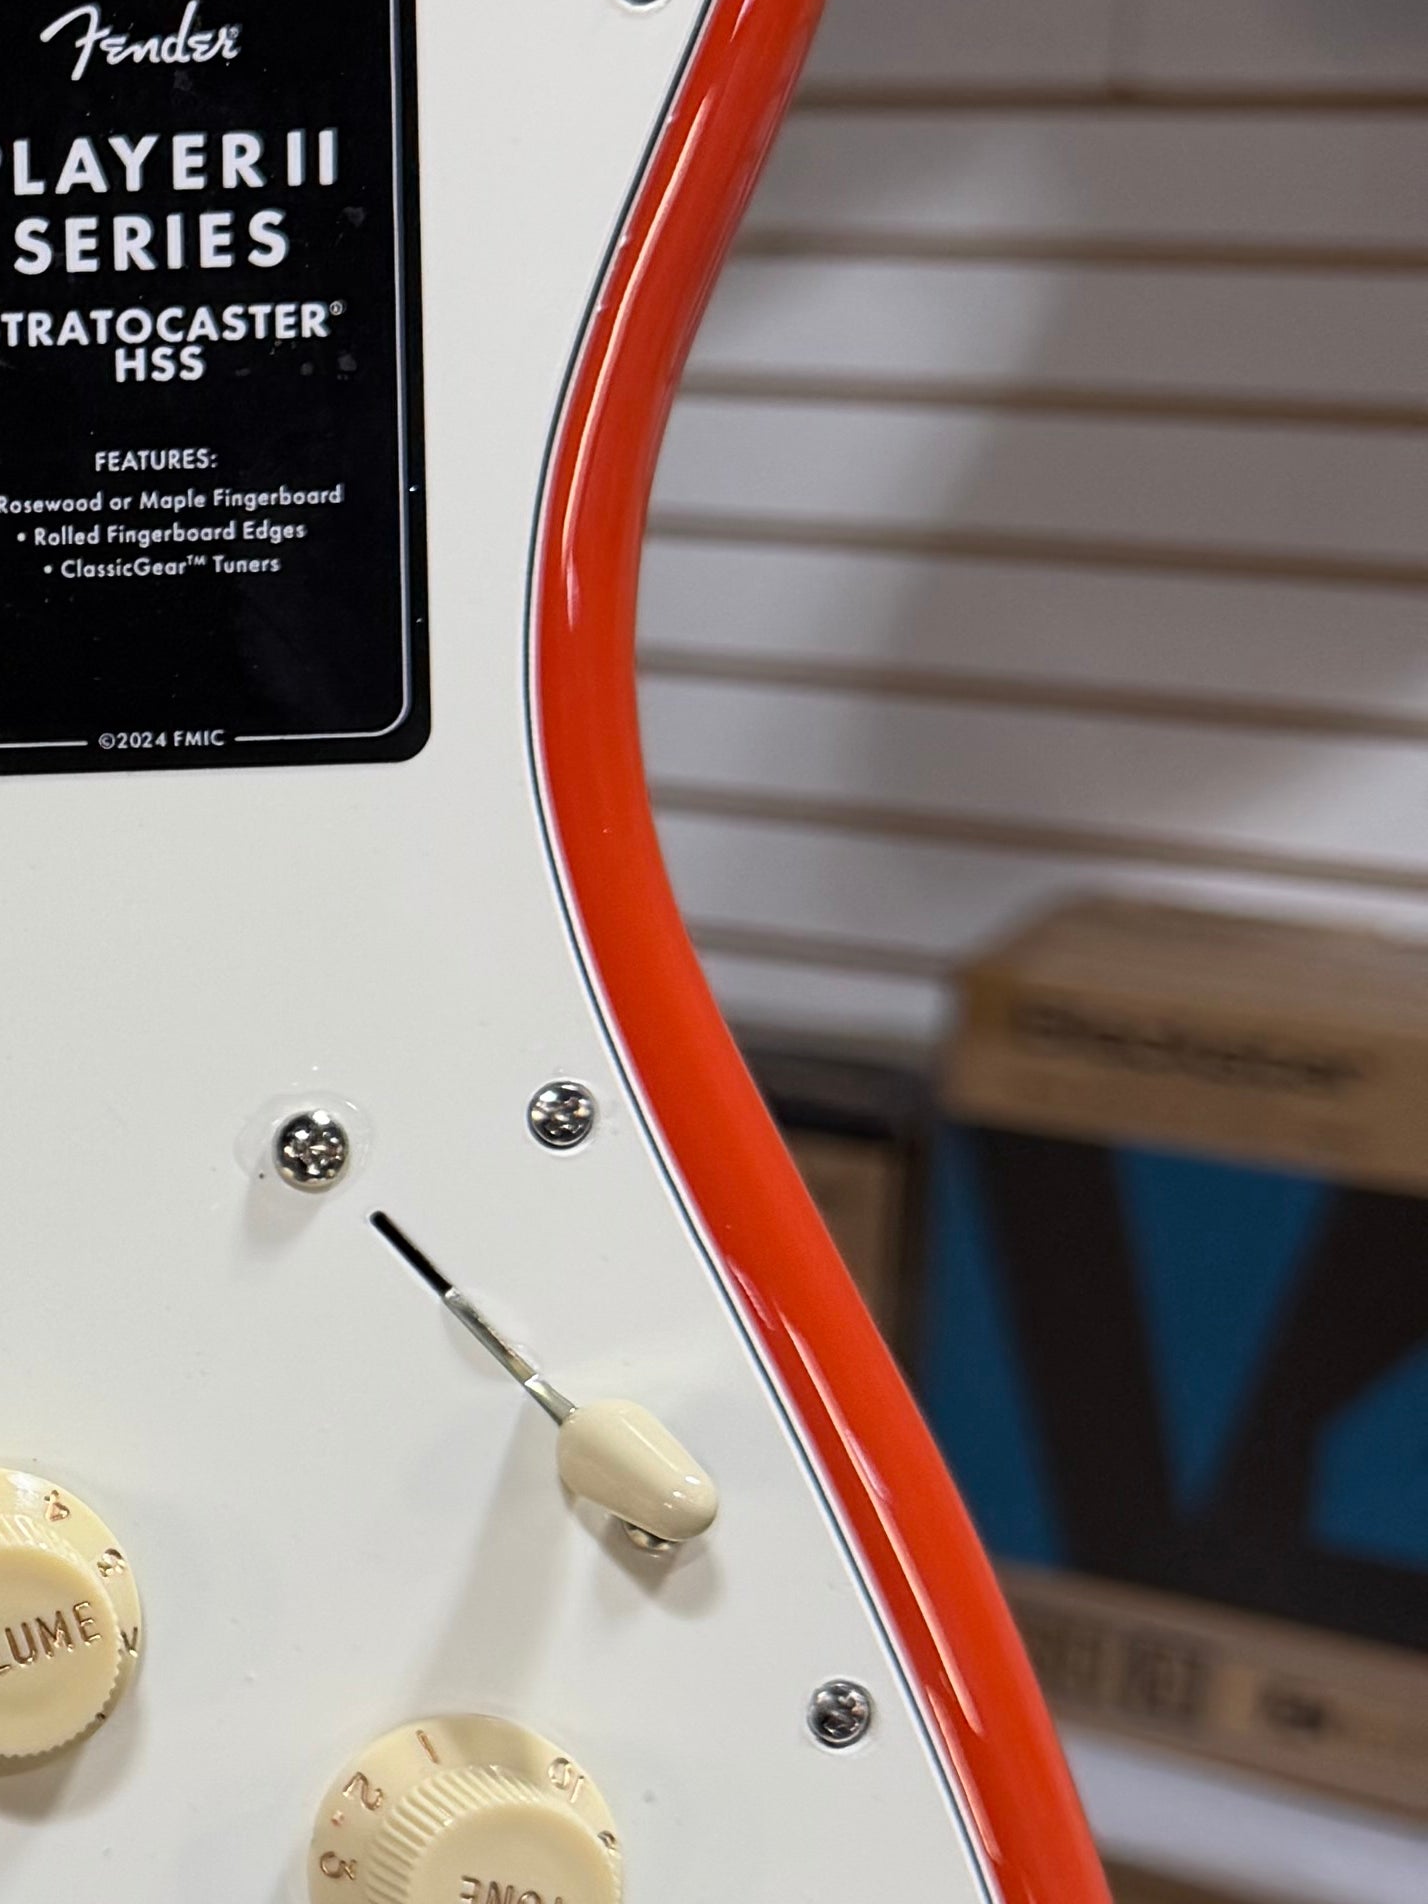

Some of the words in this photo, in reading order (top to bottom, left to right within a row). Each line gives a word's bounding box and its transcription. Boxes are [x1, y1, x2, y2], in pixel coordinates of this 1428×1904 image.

[286, 126, 339, 187] II
[12, 207, 290, 276] SERIES
[114, 344, 206, 383] HSS
[93, 447, 219, 473] FEATURES:
[109, 495, 133, 512] or
[138, 488, 207, 514] Maple
[212, 483, 345, 511] Fingerboard
[33, 524, 101, 547] Rolled
[106, 520, 237, 548] Fingerboard
[242, 518, 308, 544] Edges
[211, 554, 282, 574] Tuners
[98, 731, 167, 750] ©2024
[173, 729, 225, 747] FMIC
[44, 1489, 71, 1522] 4
[415, 1729, 441, 1765] 1
[342, 1771, 385, 1812] 2
[546, 1756, 586, 1805] 10
[318, 1850, 358, 1881] 3
